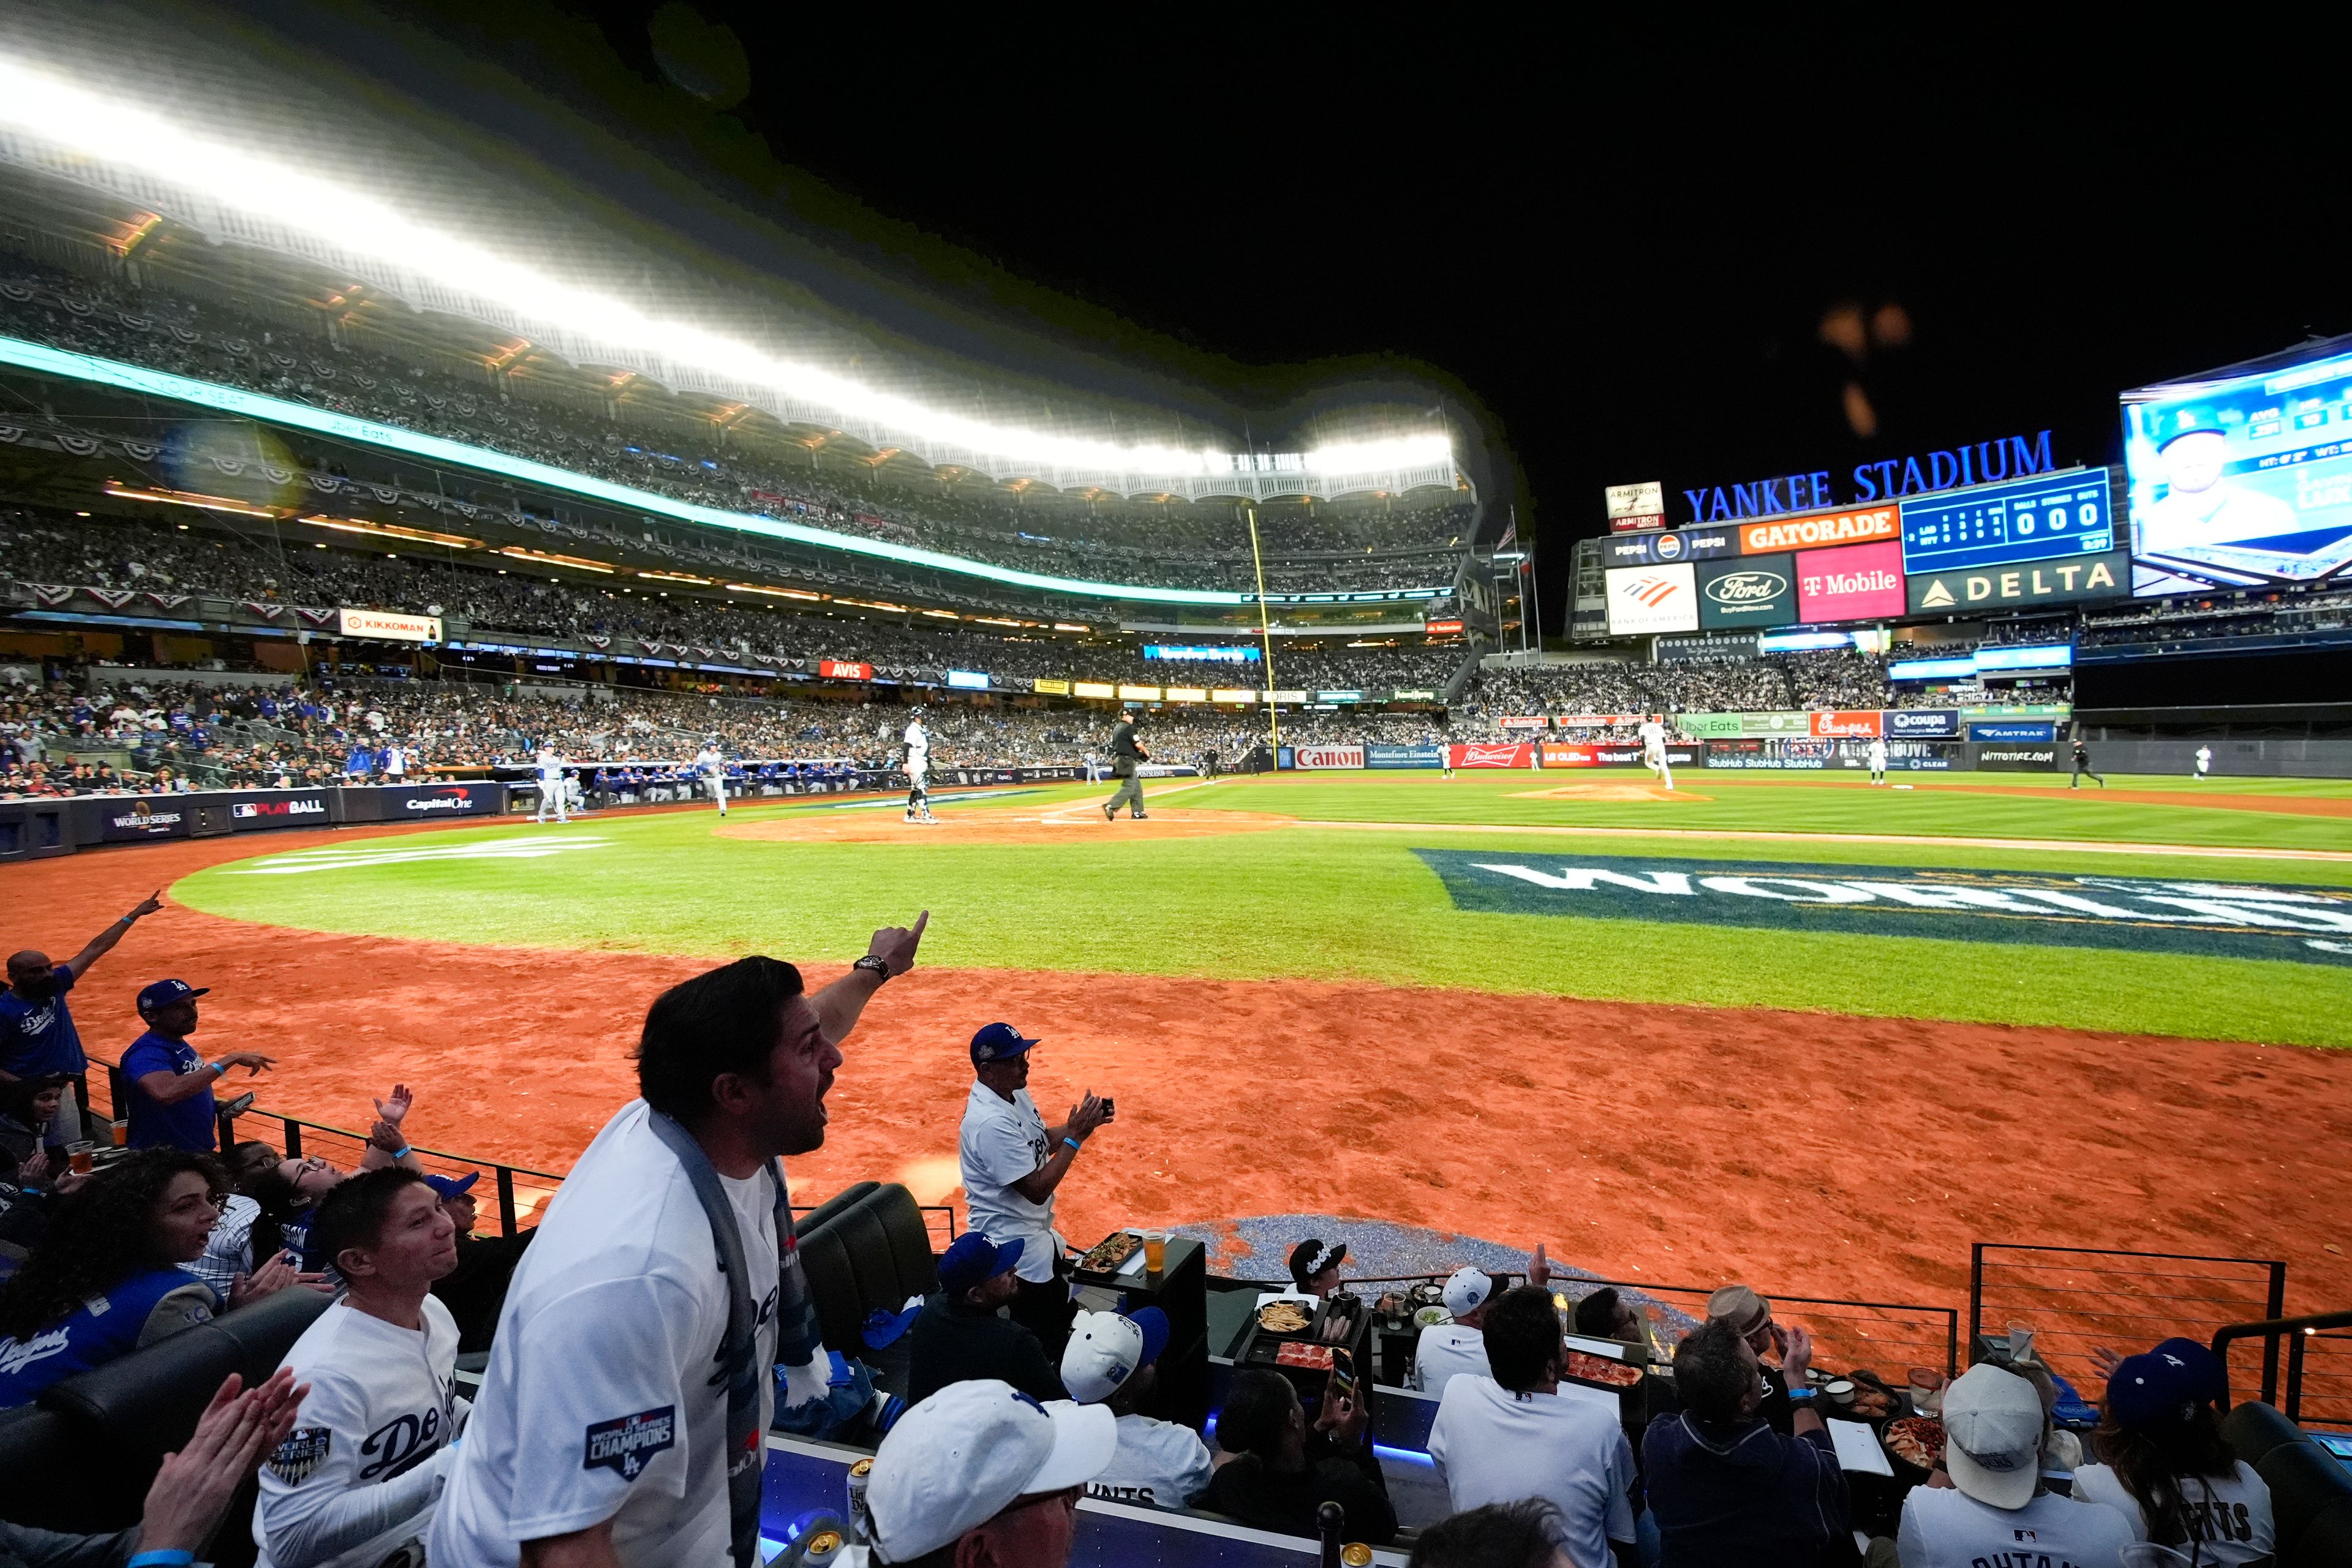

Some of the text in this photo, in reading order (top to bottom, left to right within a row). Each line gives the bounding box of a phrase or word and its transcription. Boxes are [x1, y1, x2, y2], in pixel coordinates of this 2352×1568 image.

[156, 377, 246, 409] YOUR SEAT
[326, 417, 393, 443] Uber Eats
[1683, 430, 2055, 523] YANKEE STADIUM
[1610, 488, 1658, 499] ARMITRON
[1616, 515, 1659, 526] ARMITRON
[2017, 503, 2098, 535] 0 0 0
[1749, 510, 1893, 549] GATORADE
[1692, 537, 1725, 549] PEPSI
[1615, 545, 1647, 556] PEPSI
[1720, 575, 1773, 601] Ford
[1826, 570, 1897, 595] Mobile
[1966, 562, 2115, 601] DELTA
[1720, 604, 1774, 614] BuyFordNow.com
[365, 620, 424, 633] KIKKOMAN
[1611, 617, 1636, 626] BANK
[1653, 614, 1695, 623] AMERICA
[832, 663, 861, 677] AVIS
[1272, 692, 1297, 702] ORIS
[1681, 718, 1739, 731] Uber Eats
[1909, 715, 1946, 728] coupa
[1297, 748, 1362, 767] Canon
[1370, 750, 1439, 758] Montefiore Einstein
[1466, 750, 1513, 761] Budweiser
[1544, 752, 1556, 761] LG
[1557, 752, 1580, 761] OLED
[1597, 752, 1612, 761] The
[1613, 753, 1632, 761] best
[1667, 754, 1691, 763] game
[1981, 752, 2053, 763] NITTOTIRE.COM
[1708, 759, 1743, 768] StubHub
[1746, 759, 1782, 768] StubHub
[1784, 759, 1822, 769] StubHub
[257, 800, 325, 815] PLAY BALL
[114, 813, 181, 827] WORLD SERIES
[170, 979, 187, 991] LA
[1005, 1026, 1022, 1039] LA
[982, 1235, 1000, 1249] LA
[590, 1425, 671, 1460] CHAMPIONS
[623, 1452, 641, 1476] LA
